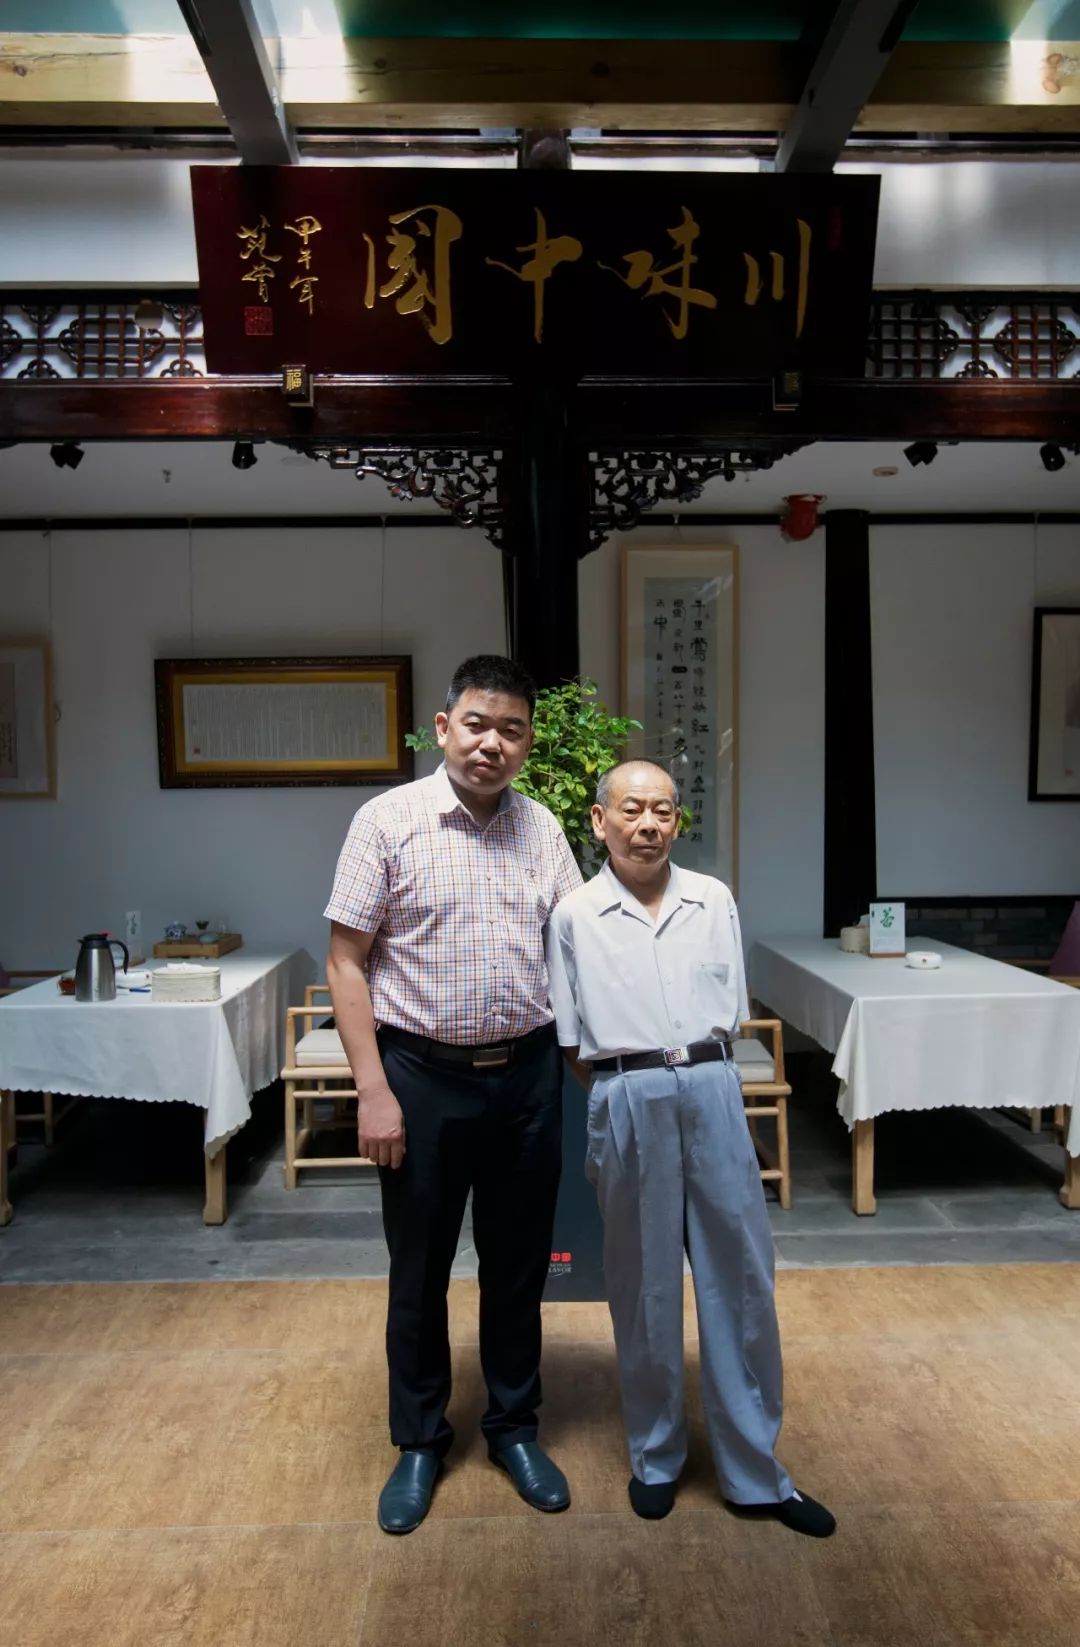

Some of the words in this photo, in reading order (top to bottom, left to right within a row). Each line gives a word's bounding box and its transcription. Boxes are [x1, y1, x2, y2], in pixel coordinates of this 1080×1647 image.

[284, 216, 322, 315] 甲午年
[286, 369, 302, 391] 福
